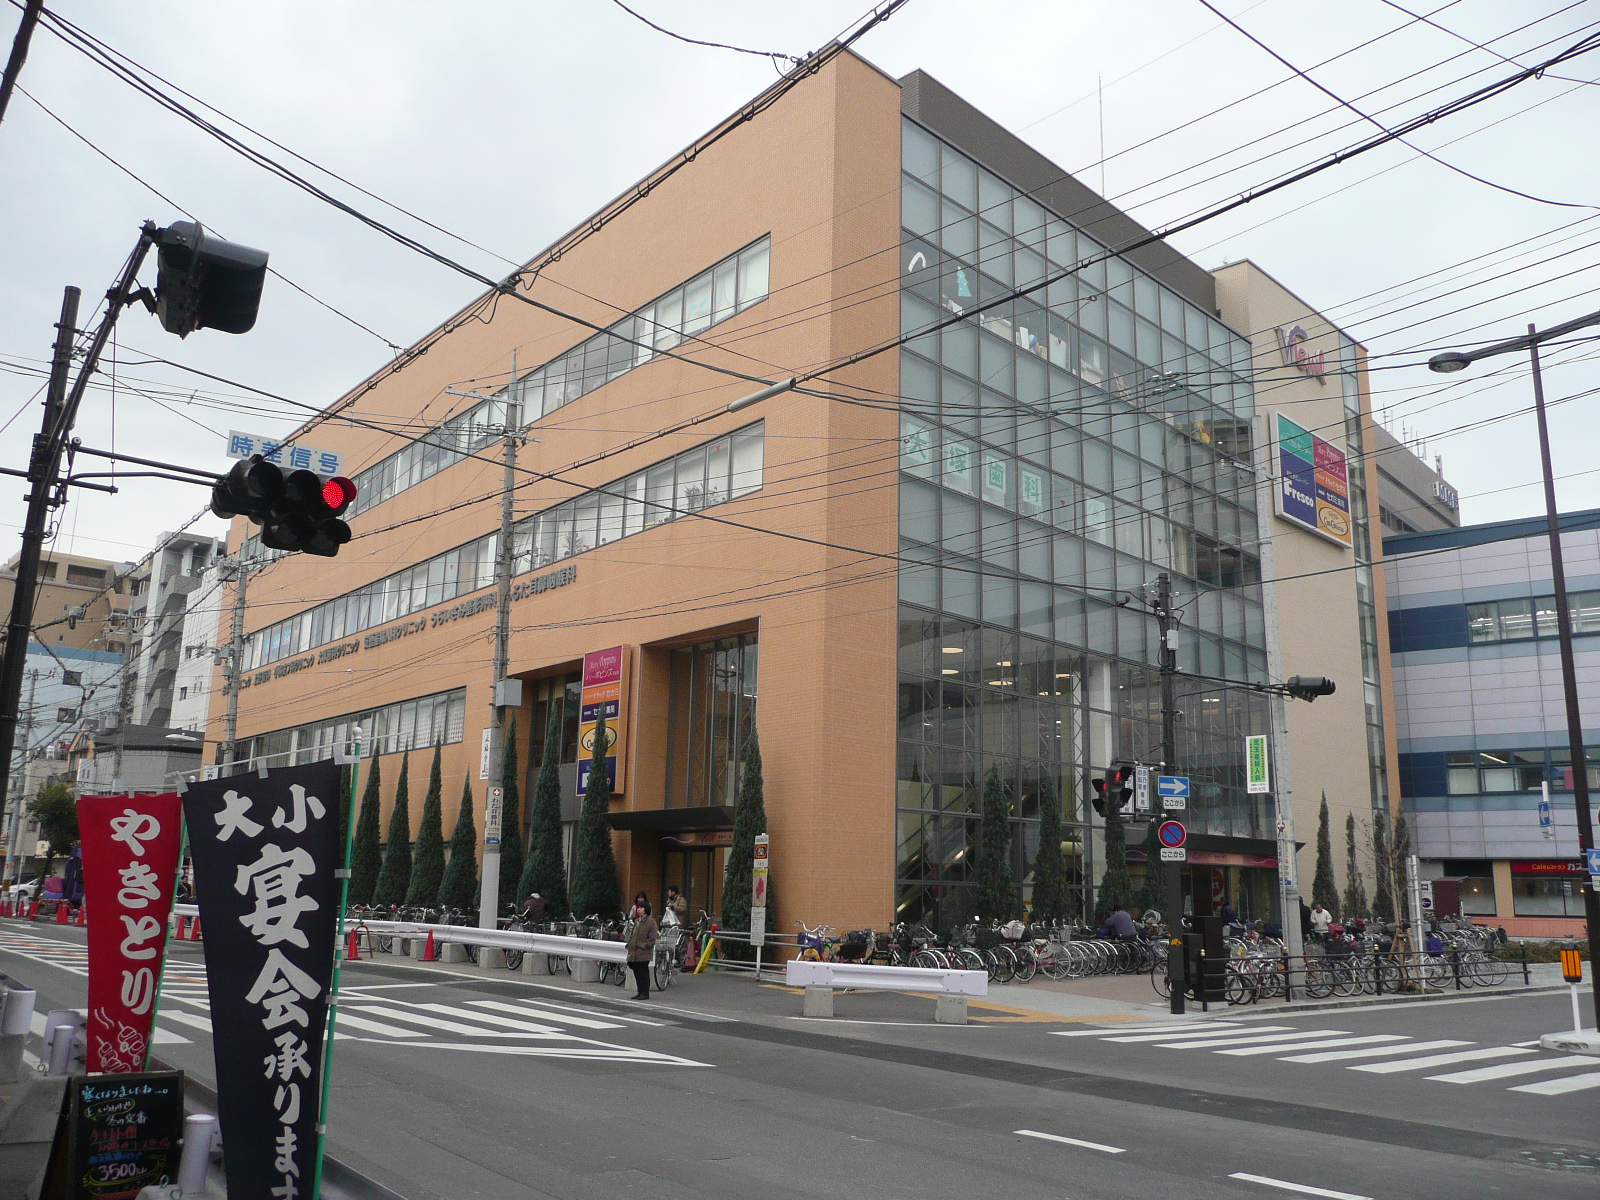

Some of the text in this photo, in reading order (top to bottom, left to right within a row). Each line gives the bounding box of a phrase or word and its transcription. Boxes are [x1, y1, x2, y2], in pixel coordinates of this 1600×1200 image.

[230, 434, 339, 474] 時差信号
[907, 432, 1040, 504] 大塚歯科
[1283, 476, 1314, 508] Fresco
[1164, 799, 1185, 807] ここから
[1161, 850, 1185, 859] ここから
[110, 808, 162, 1016] やきとり
[105, 1111, 149, 1126] 冬の定番
